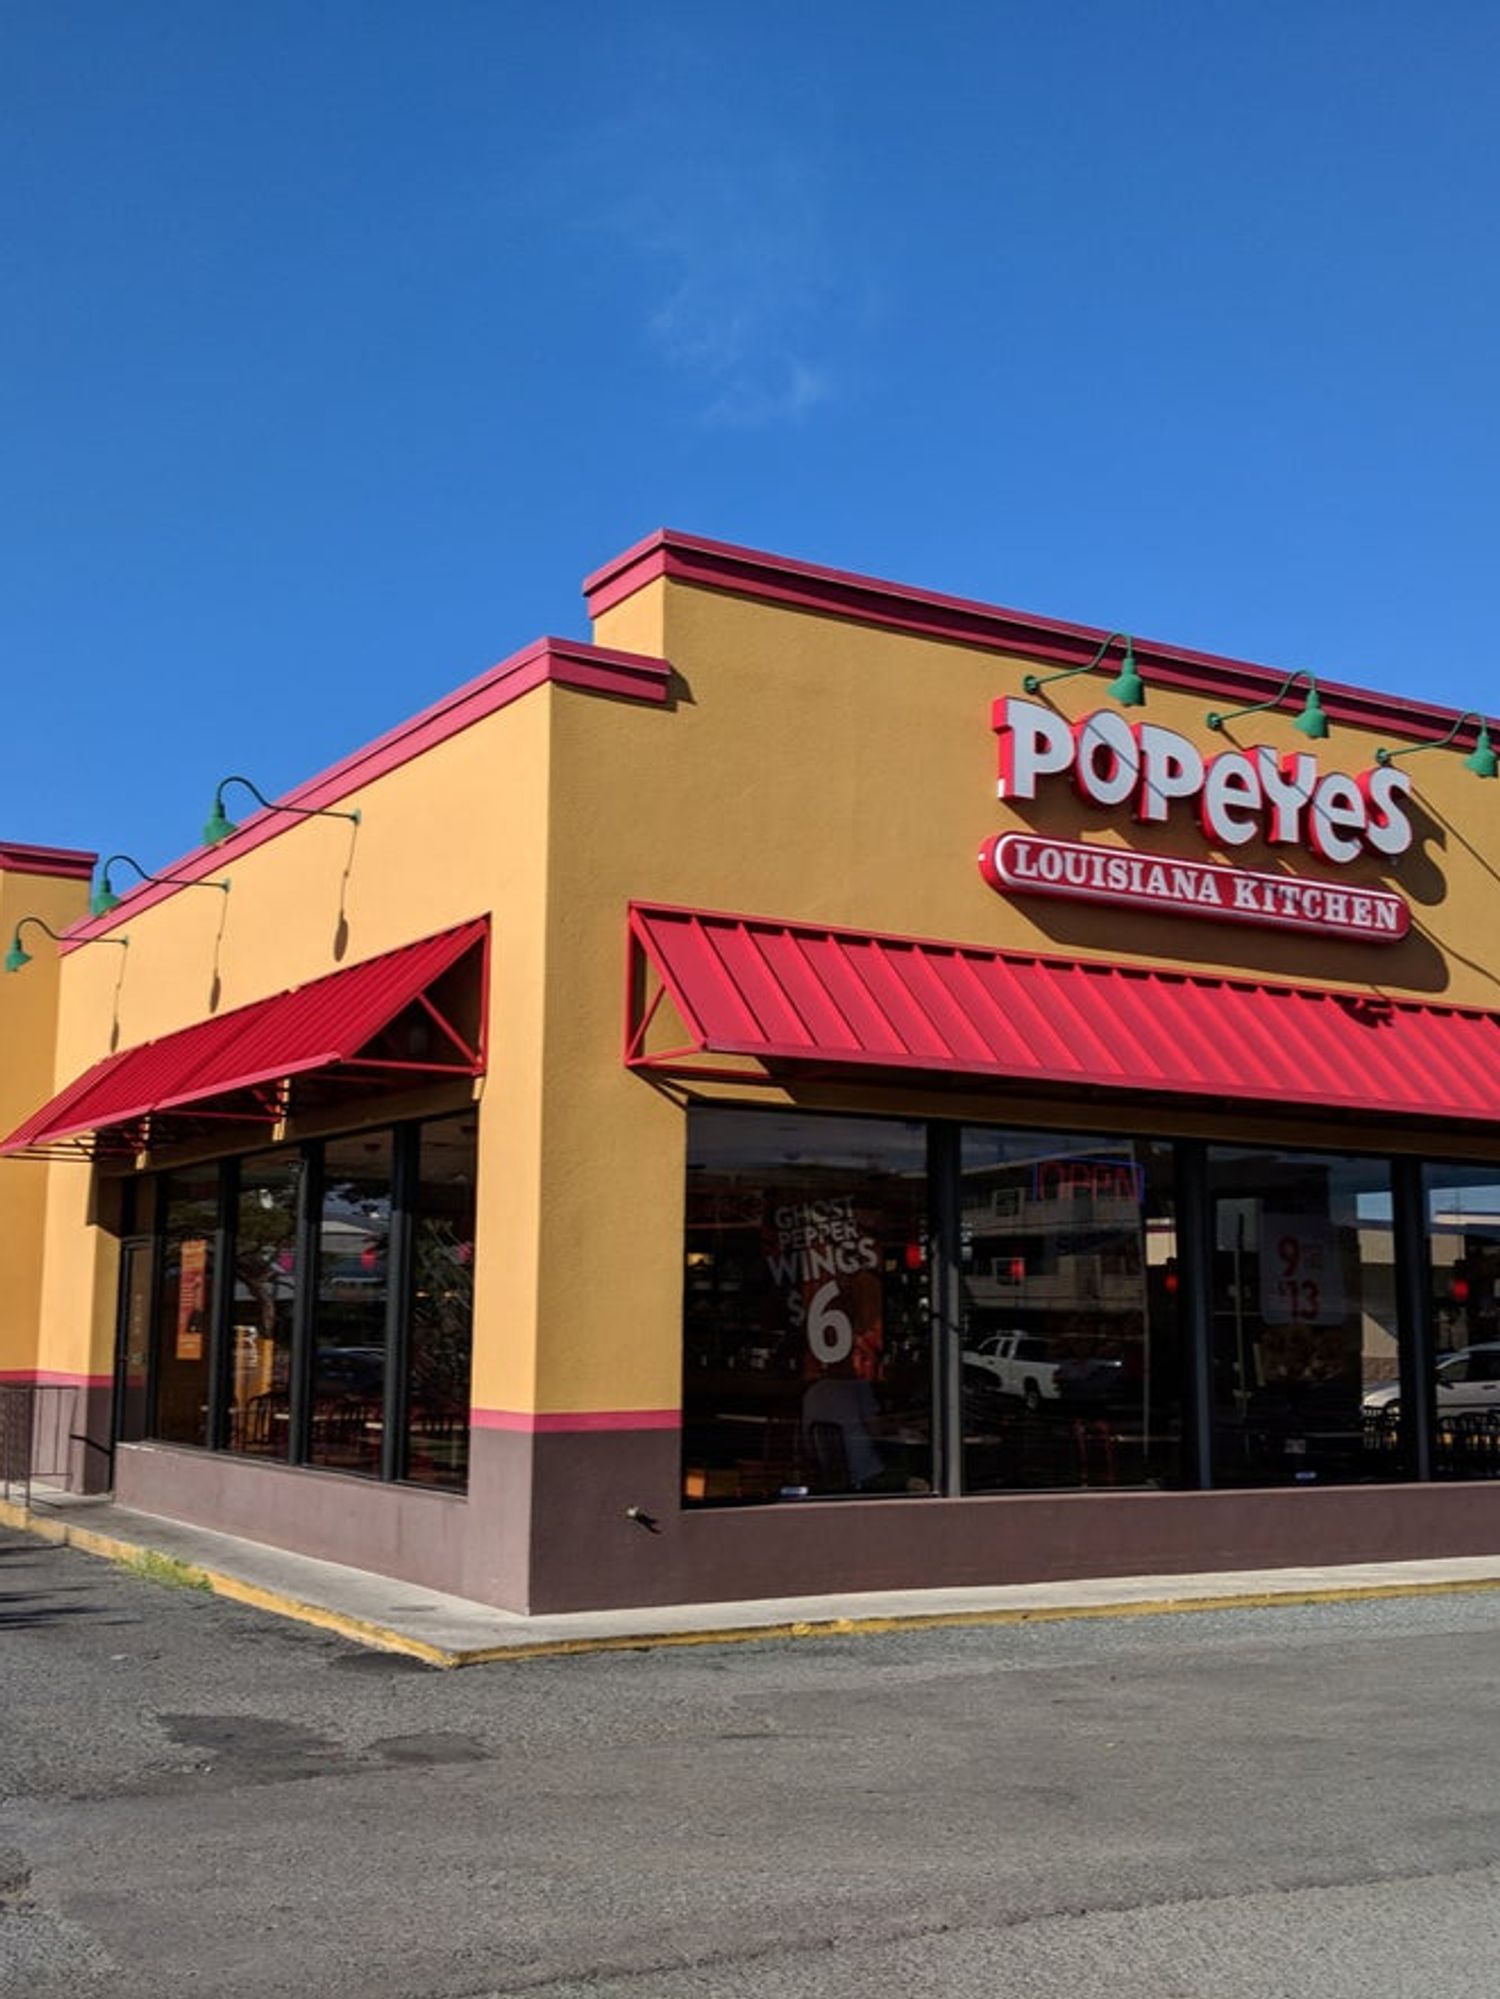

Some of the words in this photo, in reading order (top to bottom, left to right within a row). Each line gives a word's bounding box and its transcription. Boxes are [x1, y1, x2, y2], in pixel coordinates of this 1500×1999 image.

[1013, 842, 1221, 905] LOUISIANA
[1231, 877, 1401, 931] KITCHEN
[775, 1195, 856, 1229] GHOST
[779, 1219, 859, 1250] PEPPER
[766, 1238, 878, 1287] WINGS
